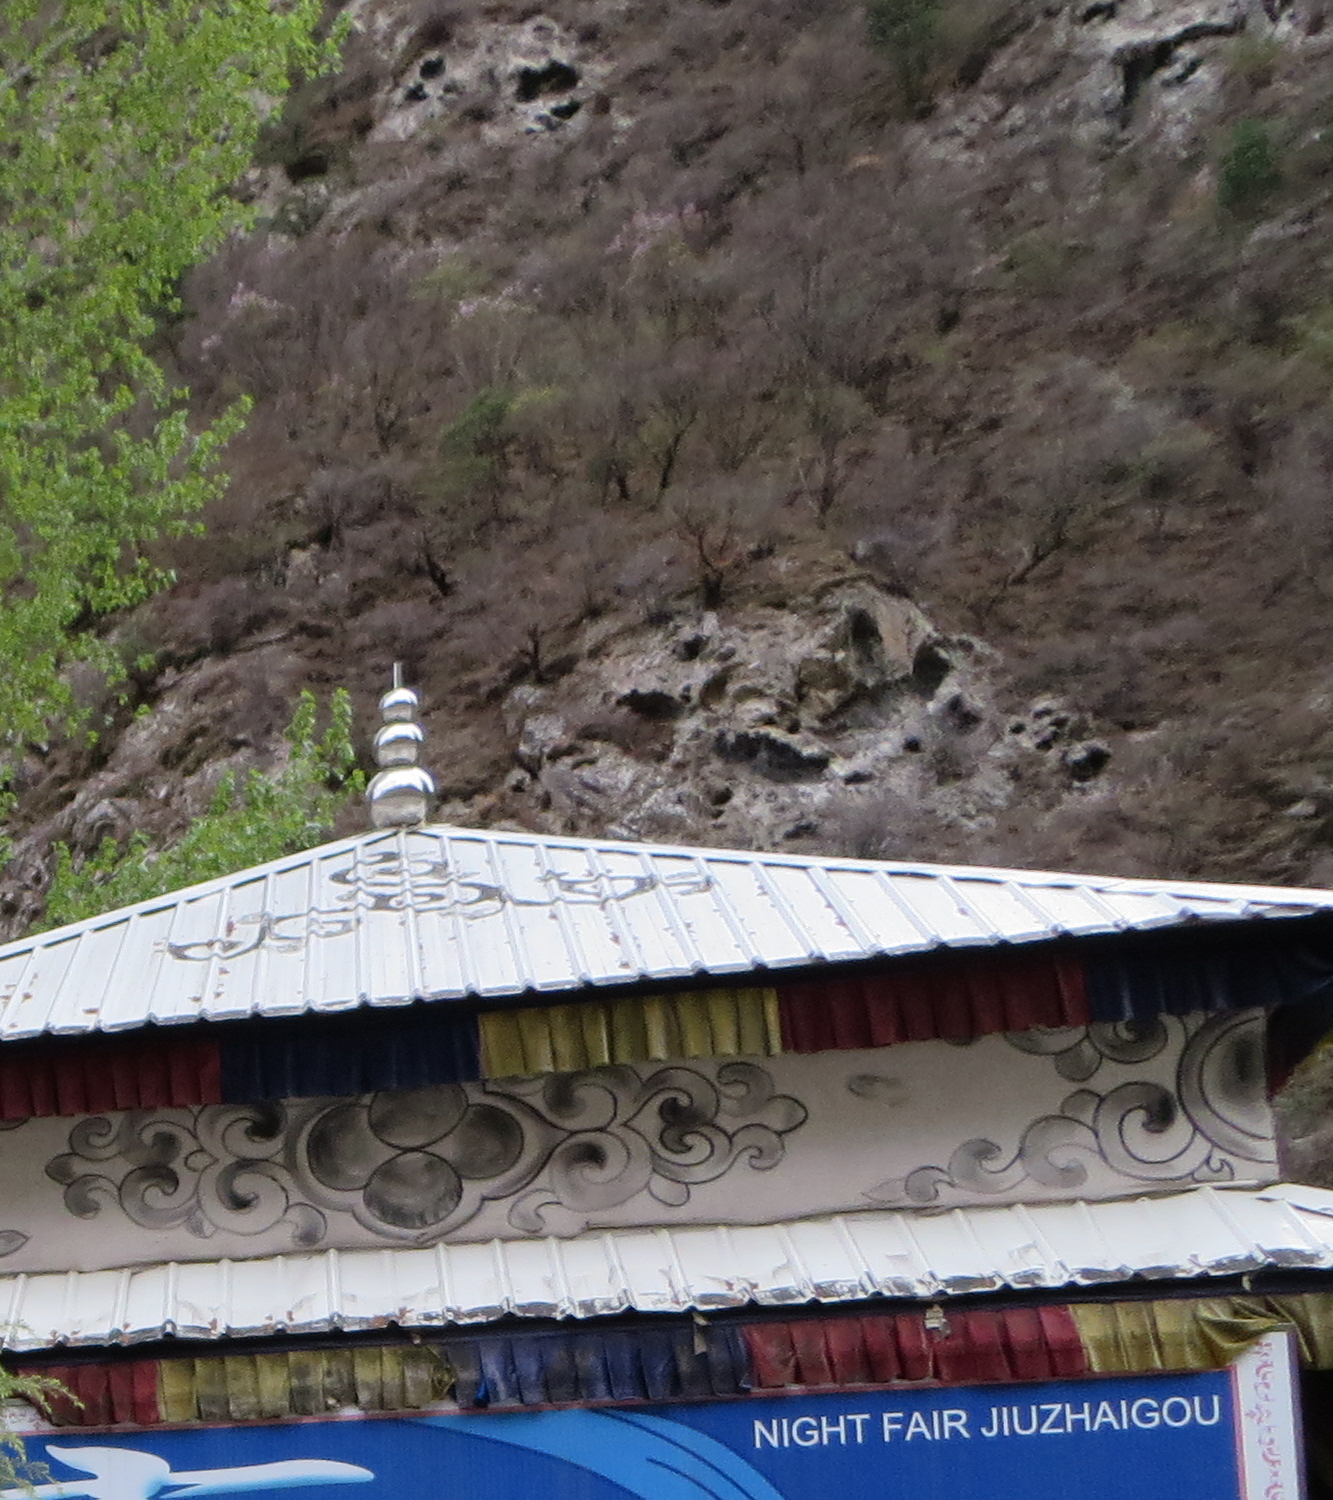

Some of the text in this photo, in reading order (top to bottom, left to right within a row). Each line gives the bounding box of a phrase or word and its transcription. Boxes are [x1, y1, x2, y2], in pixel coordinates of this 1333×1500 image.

[754, 1394, 1221, 1449] NIGHT FAIR JIUZHAIGOU
